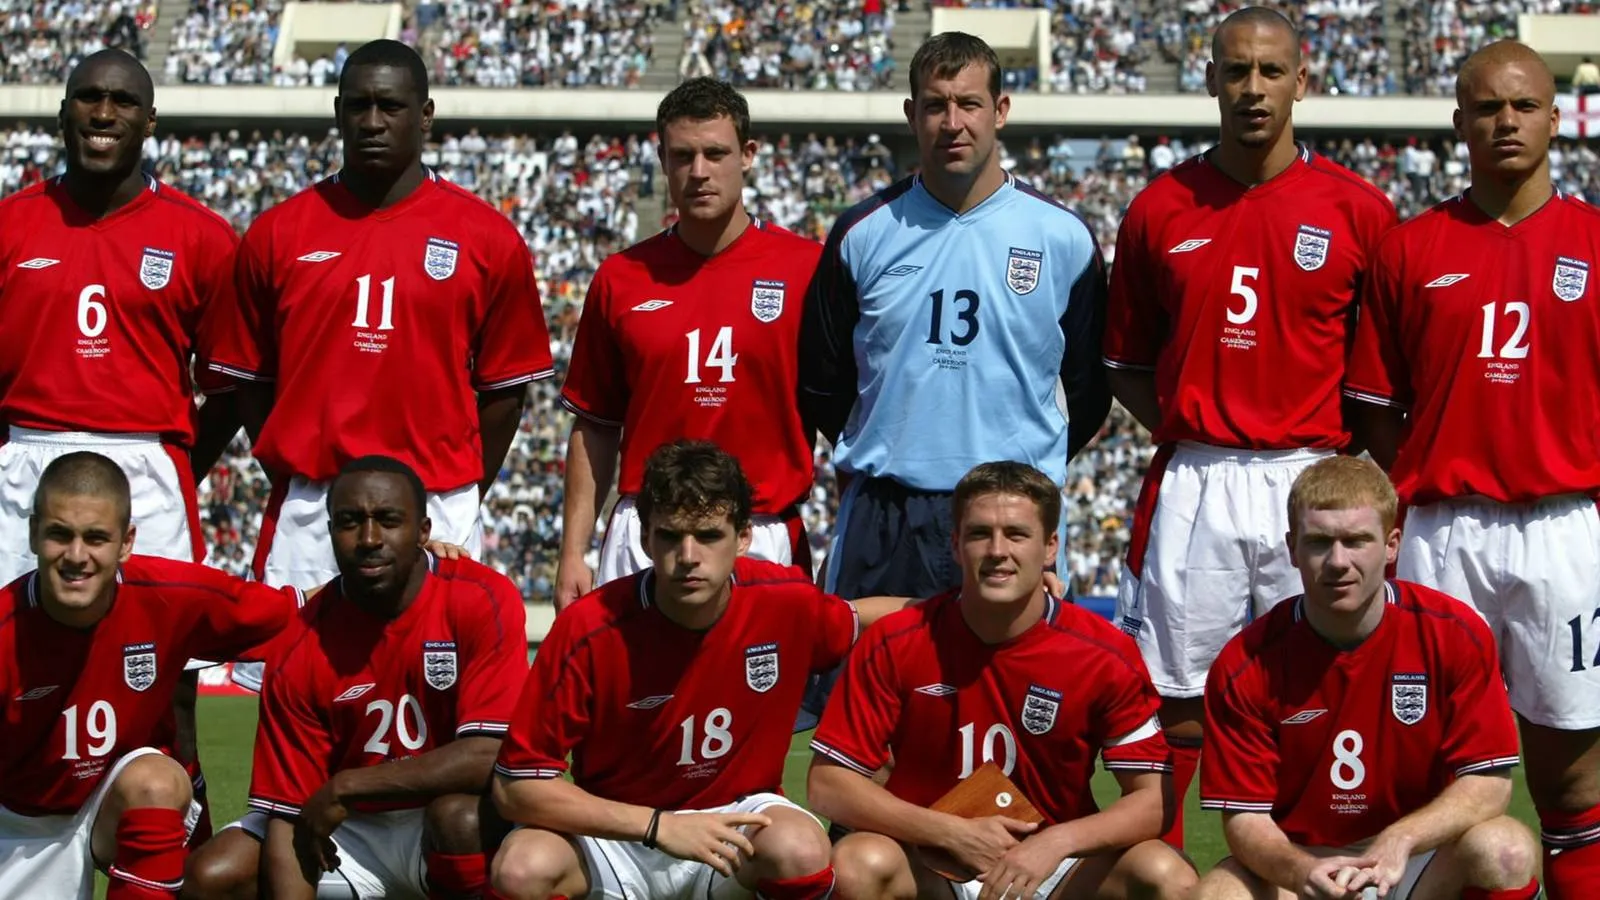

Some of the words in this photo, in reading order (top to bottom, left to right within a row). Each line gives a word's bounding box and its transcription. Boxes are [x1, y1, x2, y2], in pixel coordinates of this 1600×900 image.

[1011, 248, 1041, 258] ENGLAND
[77, 283, 108, 338] 6
[351, 273, 395, 330] 11
[925, 288, 980, 347] 13
[1226, 264, 1260, 325] 5
[77, 338, 108, 346] ENGLAND
[353, 340, 388, 349] CAMEROON
[356, 331, 388, 340] ENGLAND
[684, 326, 739, 383] 14
[935, 348, 967, 356] ENGLAND
[1220, 337, 1257, 346] CAMEROON
[1224, 327, 1256, 336] ENGLAND
[1476, 301, 1530, 359] 12
[932, 358, 968, 366] CAMEROON
[1484, 372, 1521, 380] CAMEROON
[1029, 685, 1061, 699] ENGLAND
[61, 699, 117, 760] 19
[364, 693, 428, 756] 20
[675, 707, 733, 766] 18
[958, 721, 1017, 780] 10
[1329, 729, 1366, 791] 8
